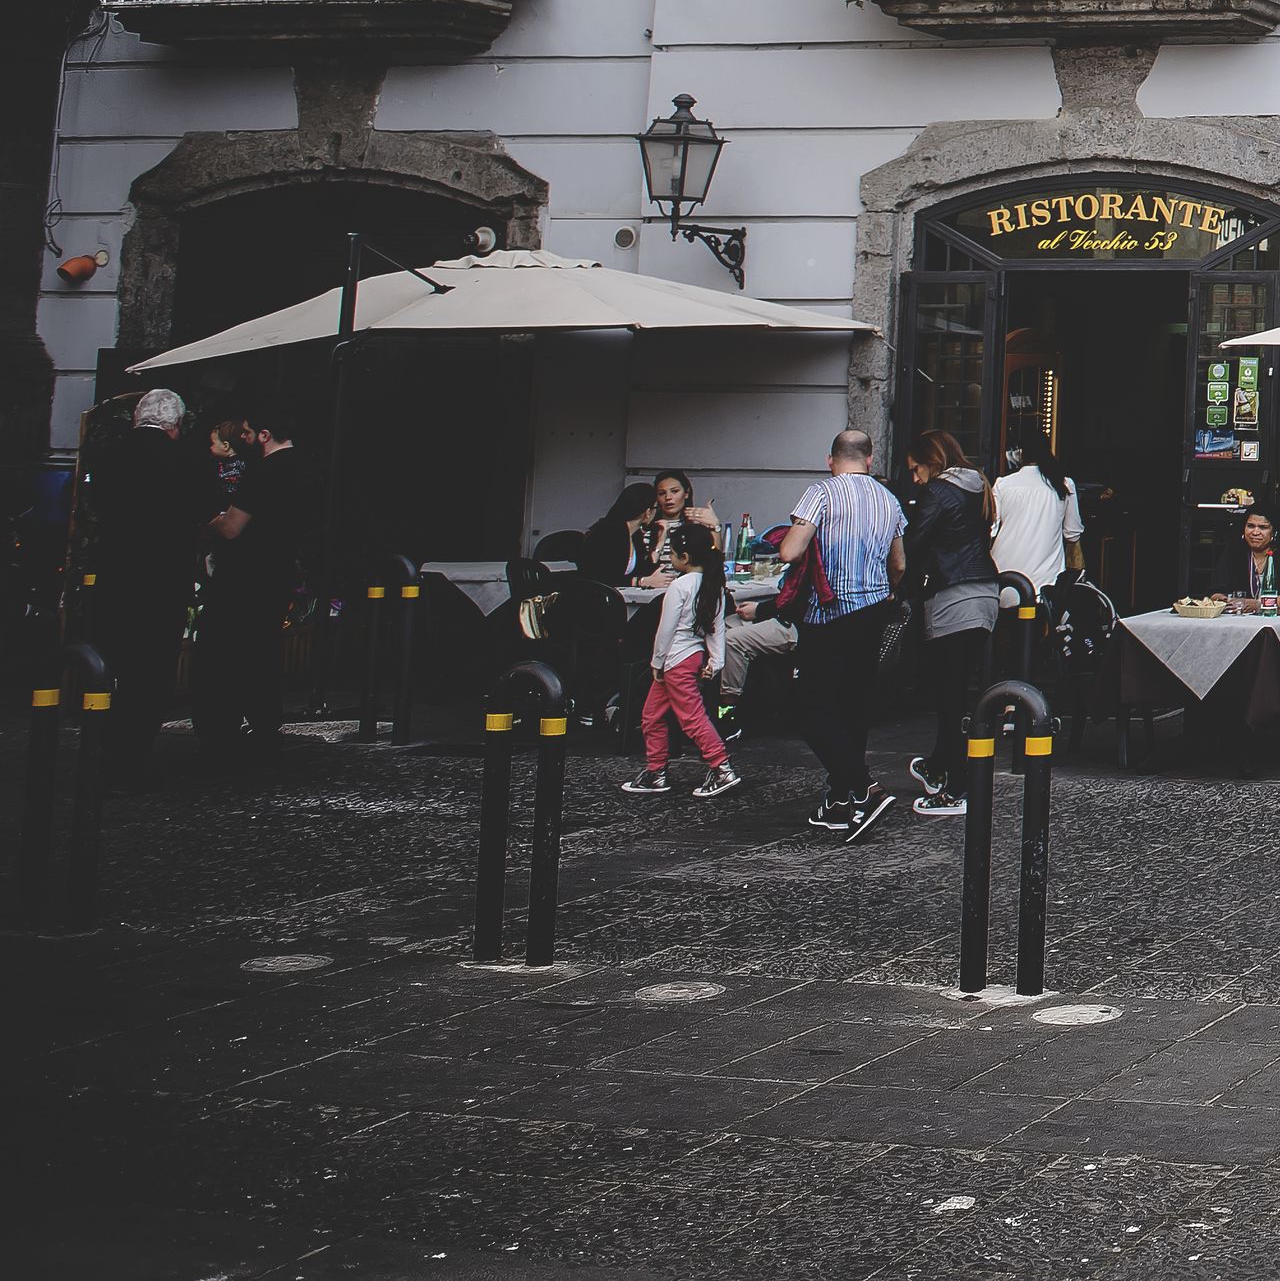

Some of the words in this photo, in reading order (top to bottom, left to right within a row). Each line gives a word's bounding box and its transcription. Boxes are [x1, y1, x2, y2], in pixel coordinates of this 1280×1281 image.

[987, 194, 1226, 236] RISTORANTE
[1037, 231, 1068, 250] al
[1069, 229, 1139, 251] Vecchio
[1144, 231, 1178, 251] 53
